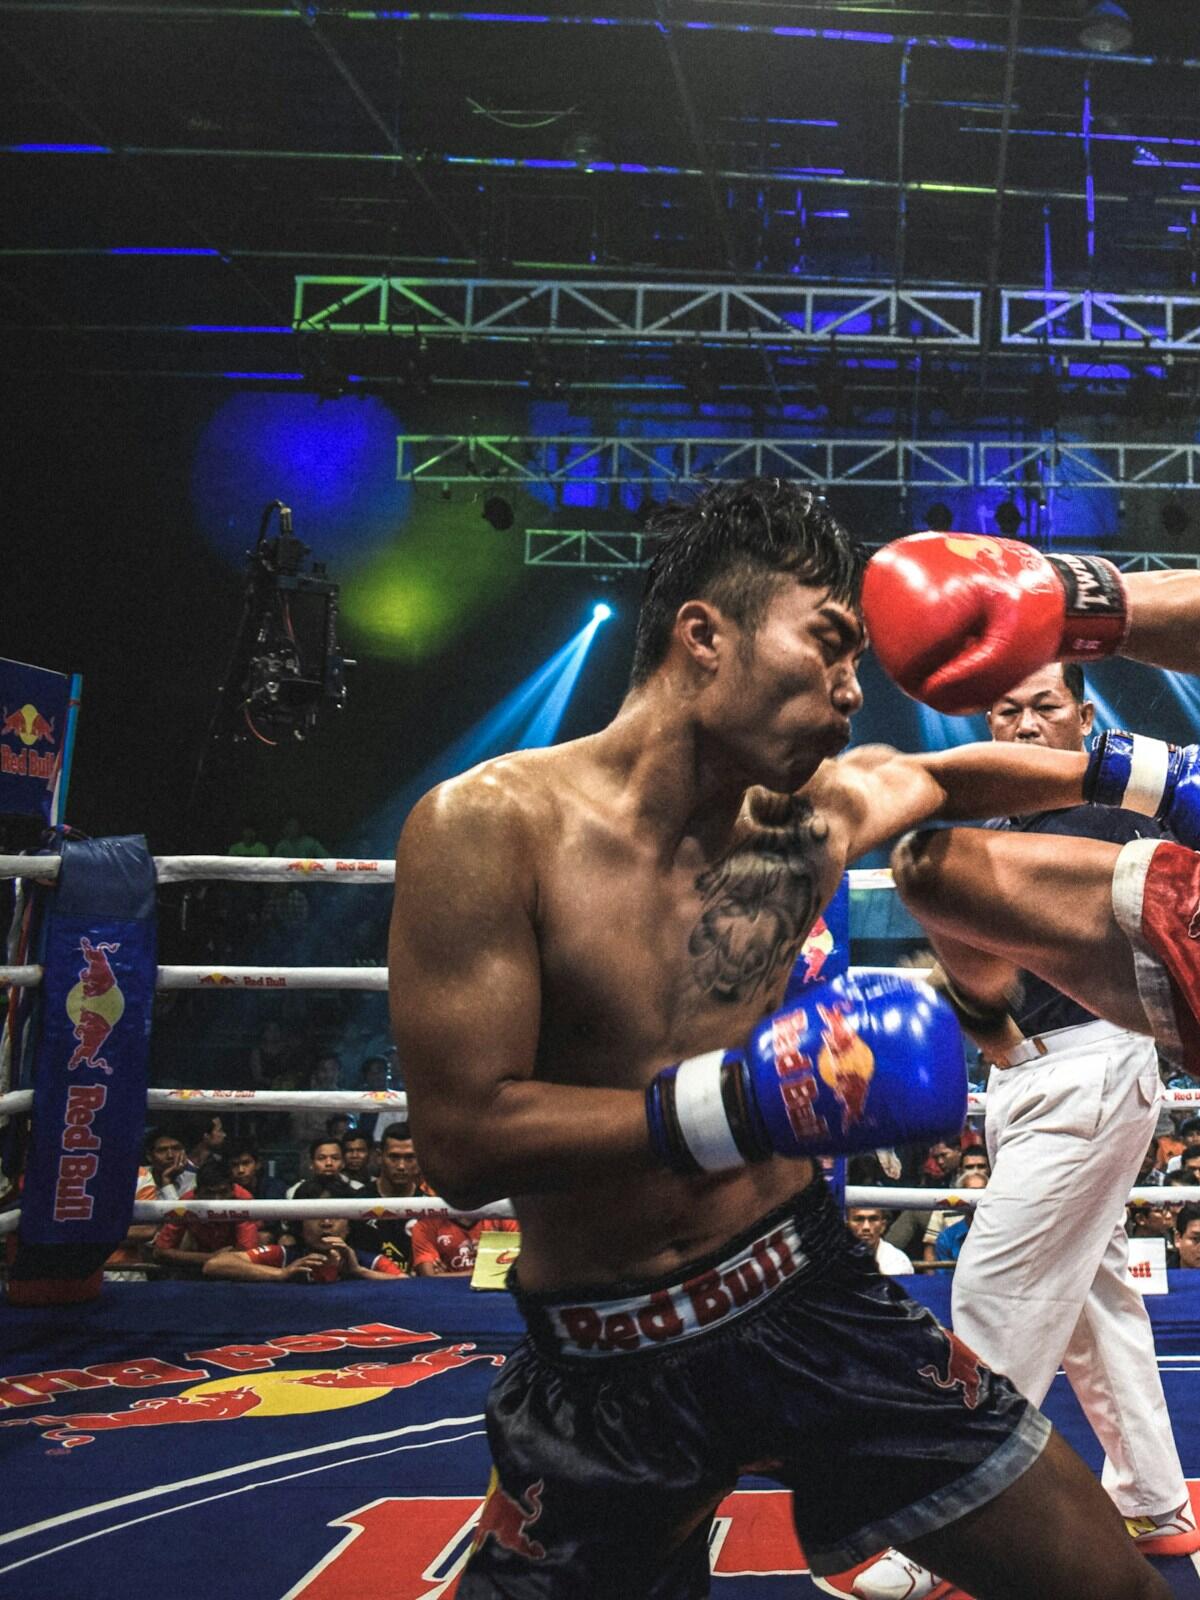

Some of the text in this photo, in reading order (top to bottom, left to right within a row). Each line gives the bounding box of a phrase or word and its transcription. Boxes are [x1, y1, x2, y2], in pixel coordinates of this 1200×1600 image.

[1, 743, 27, 776] Red
[1174, 1092, 1193, 1101] Red
[53, 1083, 108, 1222] Red Bull
[559, 1230, 797, 1351] Red Bull
[1128, 1260, 1152, 1278] ull
[0, 1322, 442, 1410] Red Bul
